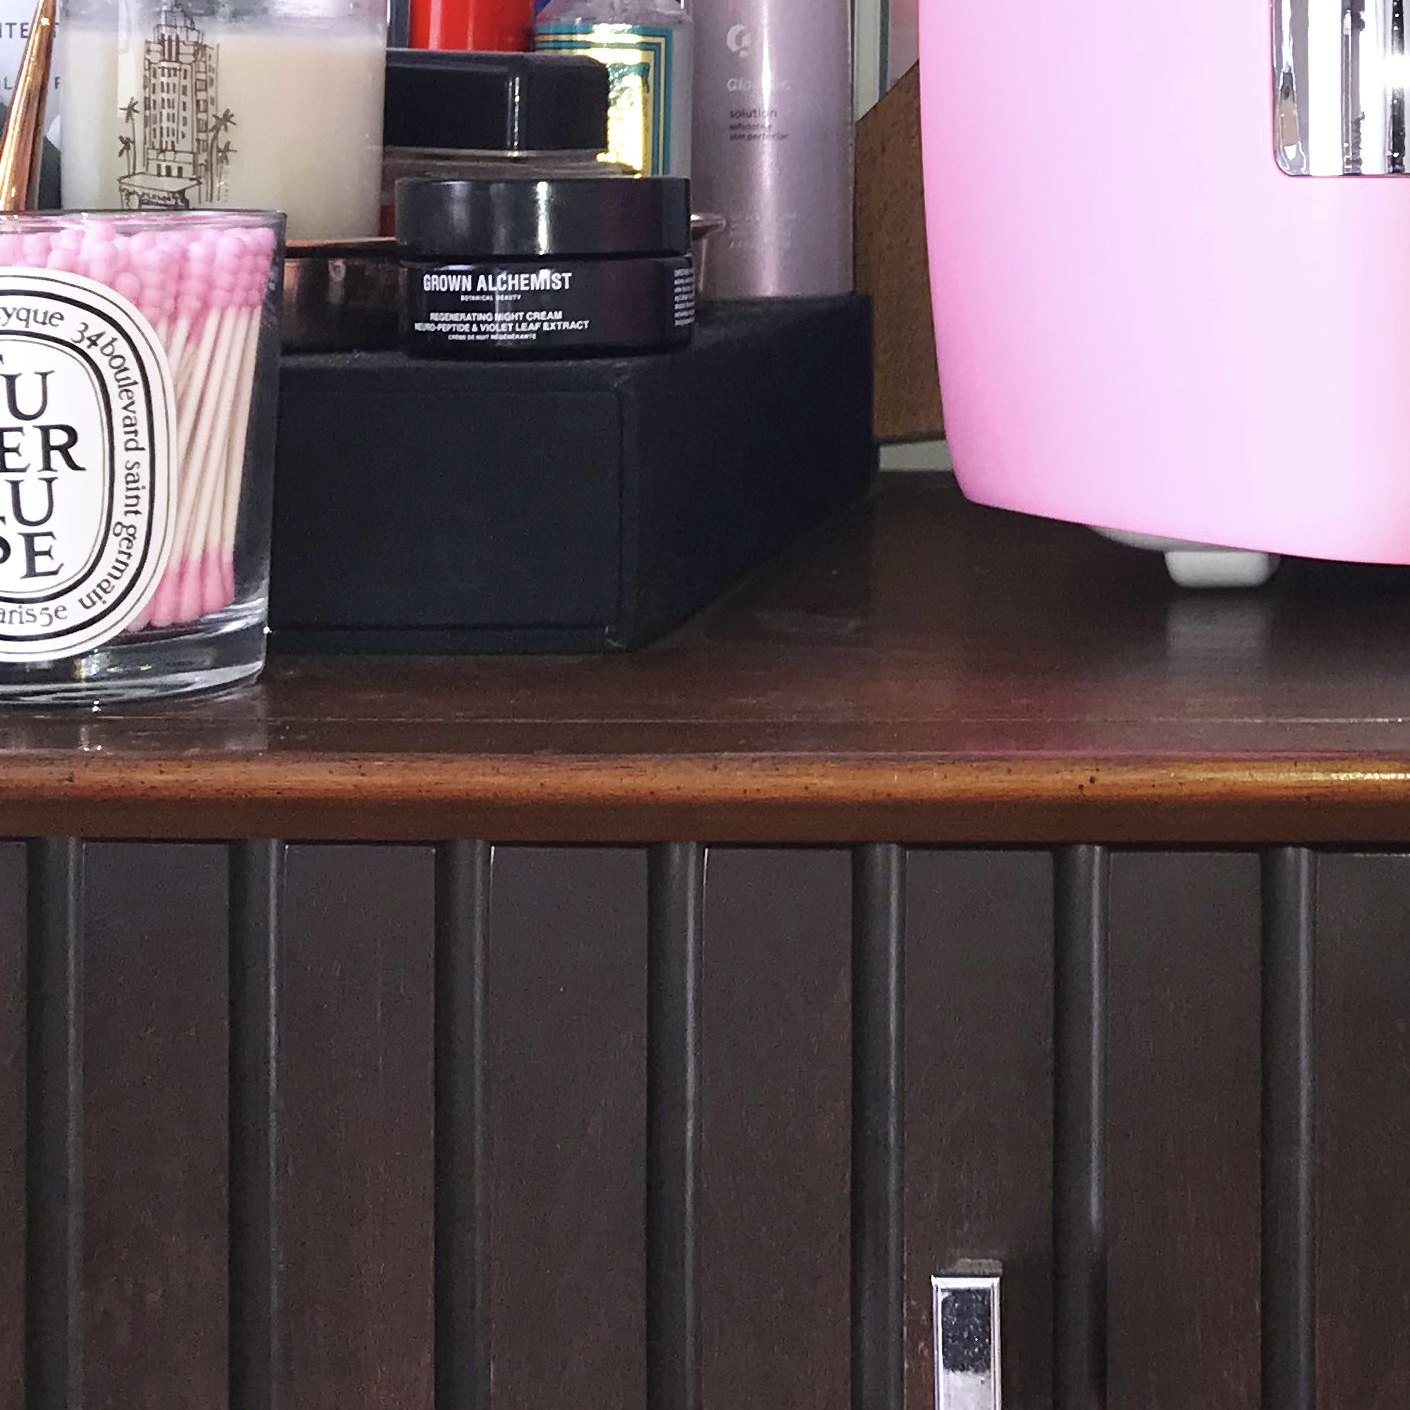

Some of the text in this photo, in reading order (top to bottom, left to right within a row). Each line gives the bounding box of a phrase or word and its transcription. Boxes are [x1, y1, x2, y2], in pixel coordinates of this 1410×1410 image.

[423, 272, 573, 292] GROWN ALCHEMIST
[0, 306, 64, 329] yque
[429, 310, 563, 322] REGENERATING NIGHT CREAM
[479, 322, 514, 332] VIOLET
[515, 322, 541, 332] LEAF
[542, 320, 590, 332] EXTRACT
[0, 369, 55, 421] U
[0, 476, 59, 527] U
[125, 460, 146, 517] saint
[78, 520, 137, 610] germain
